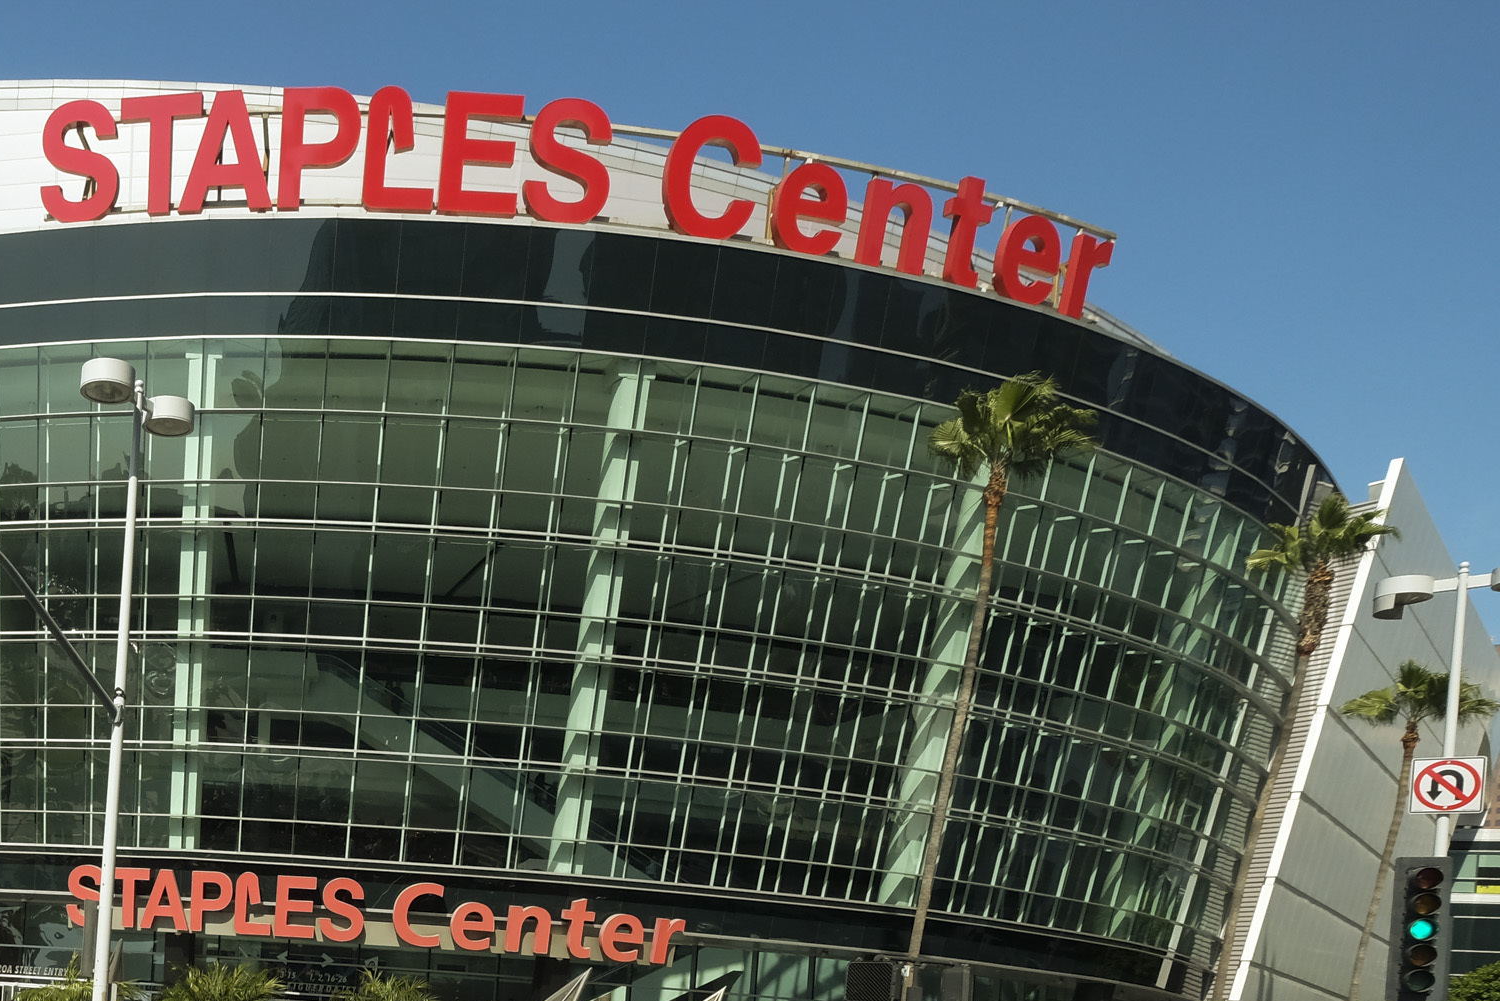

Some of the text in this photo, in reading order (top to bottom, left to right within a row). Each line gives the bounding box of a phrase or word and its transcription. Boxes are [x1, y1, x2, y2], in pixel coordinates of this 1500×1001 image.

[39, 84, 1114, 319] STAPLES Center
[67, 864, 686, 968] STAPLES Center
[14, 965, 42, 975] STREET
[43, 966, 69, 977] ENTRY
[327, 972, 348, 983] 16-26
